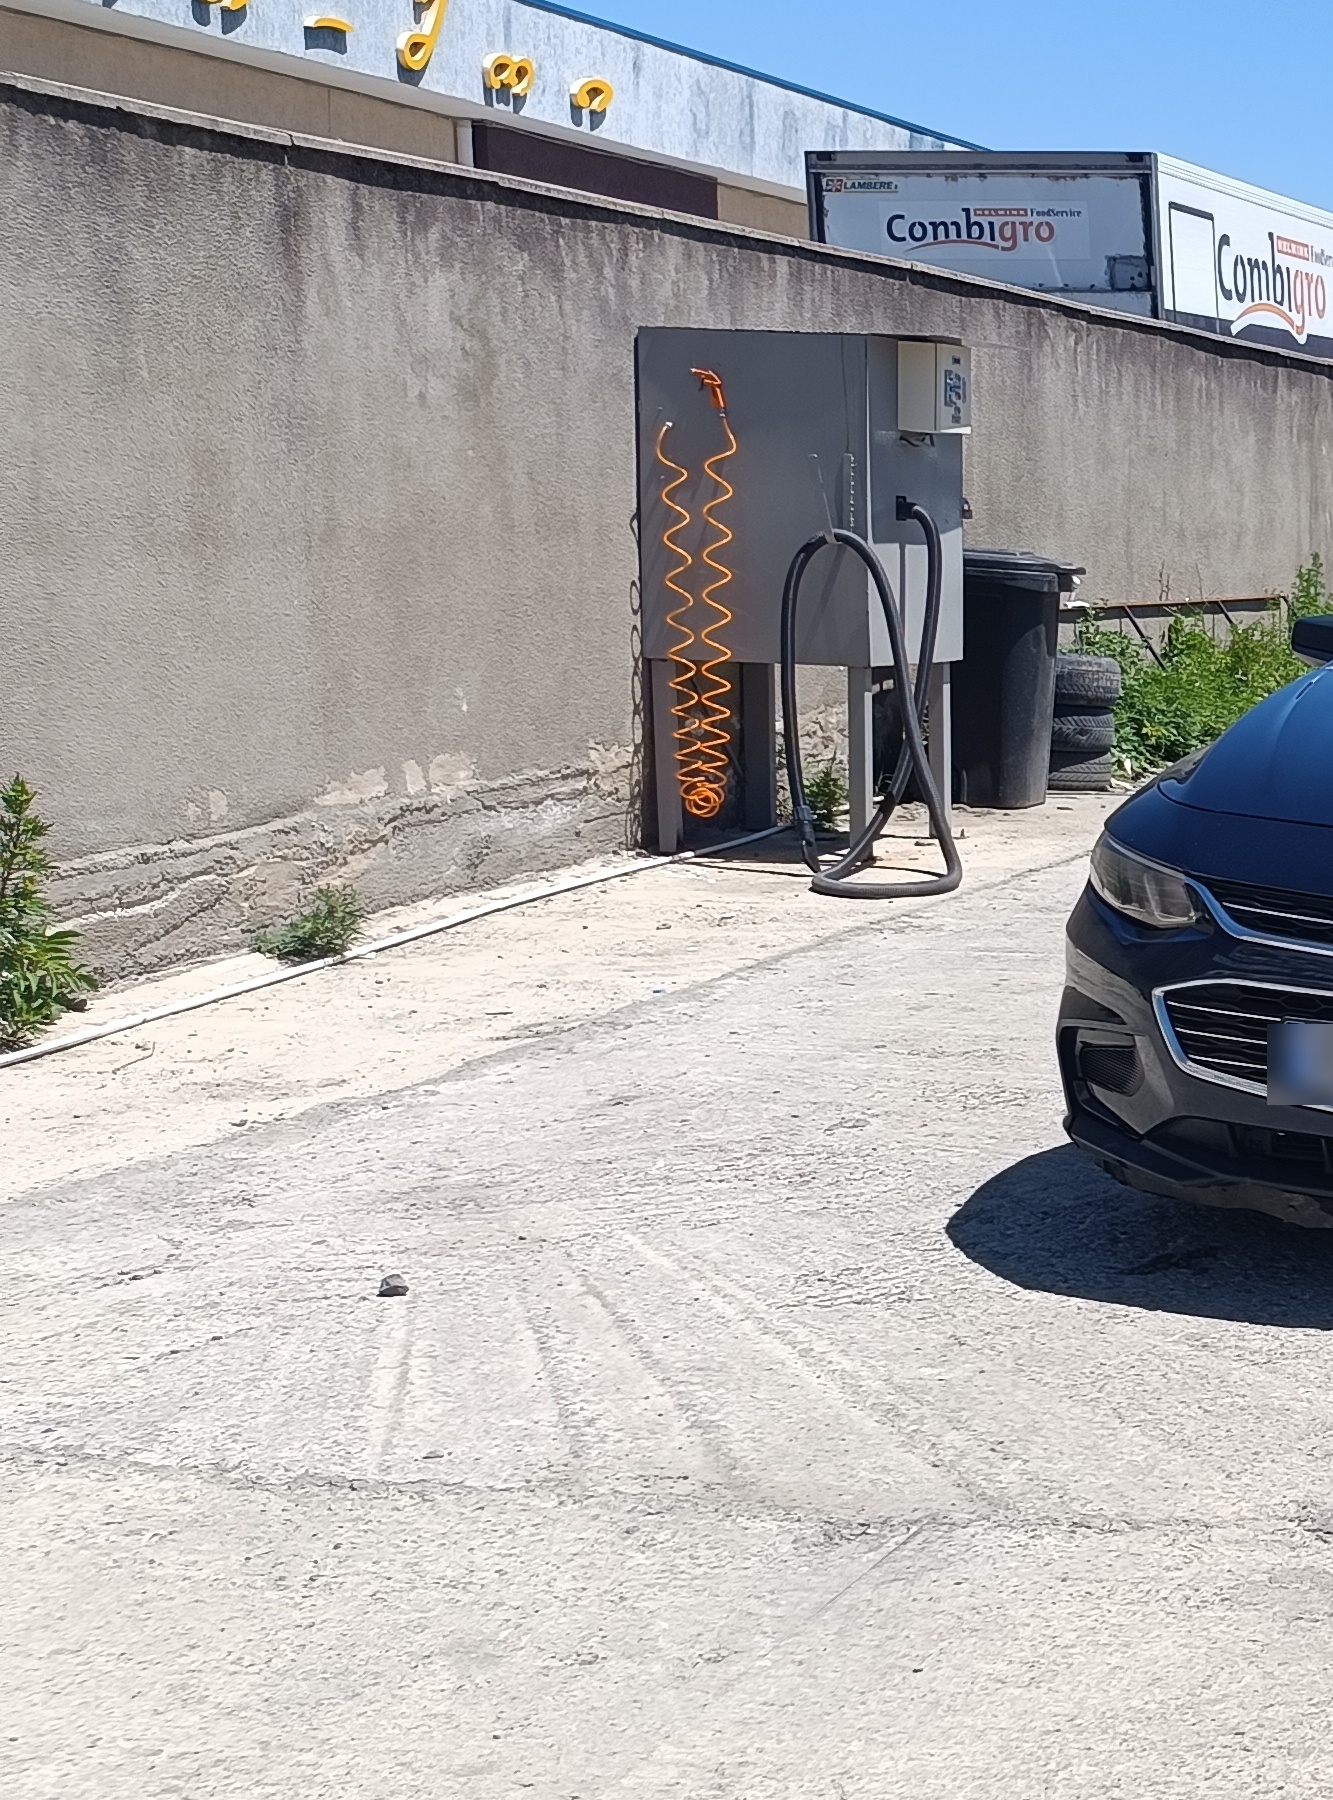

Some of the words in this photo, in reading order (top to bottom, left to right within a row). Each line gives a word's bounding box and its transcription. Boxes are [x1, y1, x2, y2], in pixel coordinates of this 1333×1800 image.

[886, 207, 1055, 251] Combigro
[1030, 207, 1082, 217] FoodService
[1217, 231, 1326, 335] Combigro
